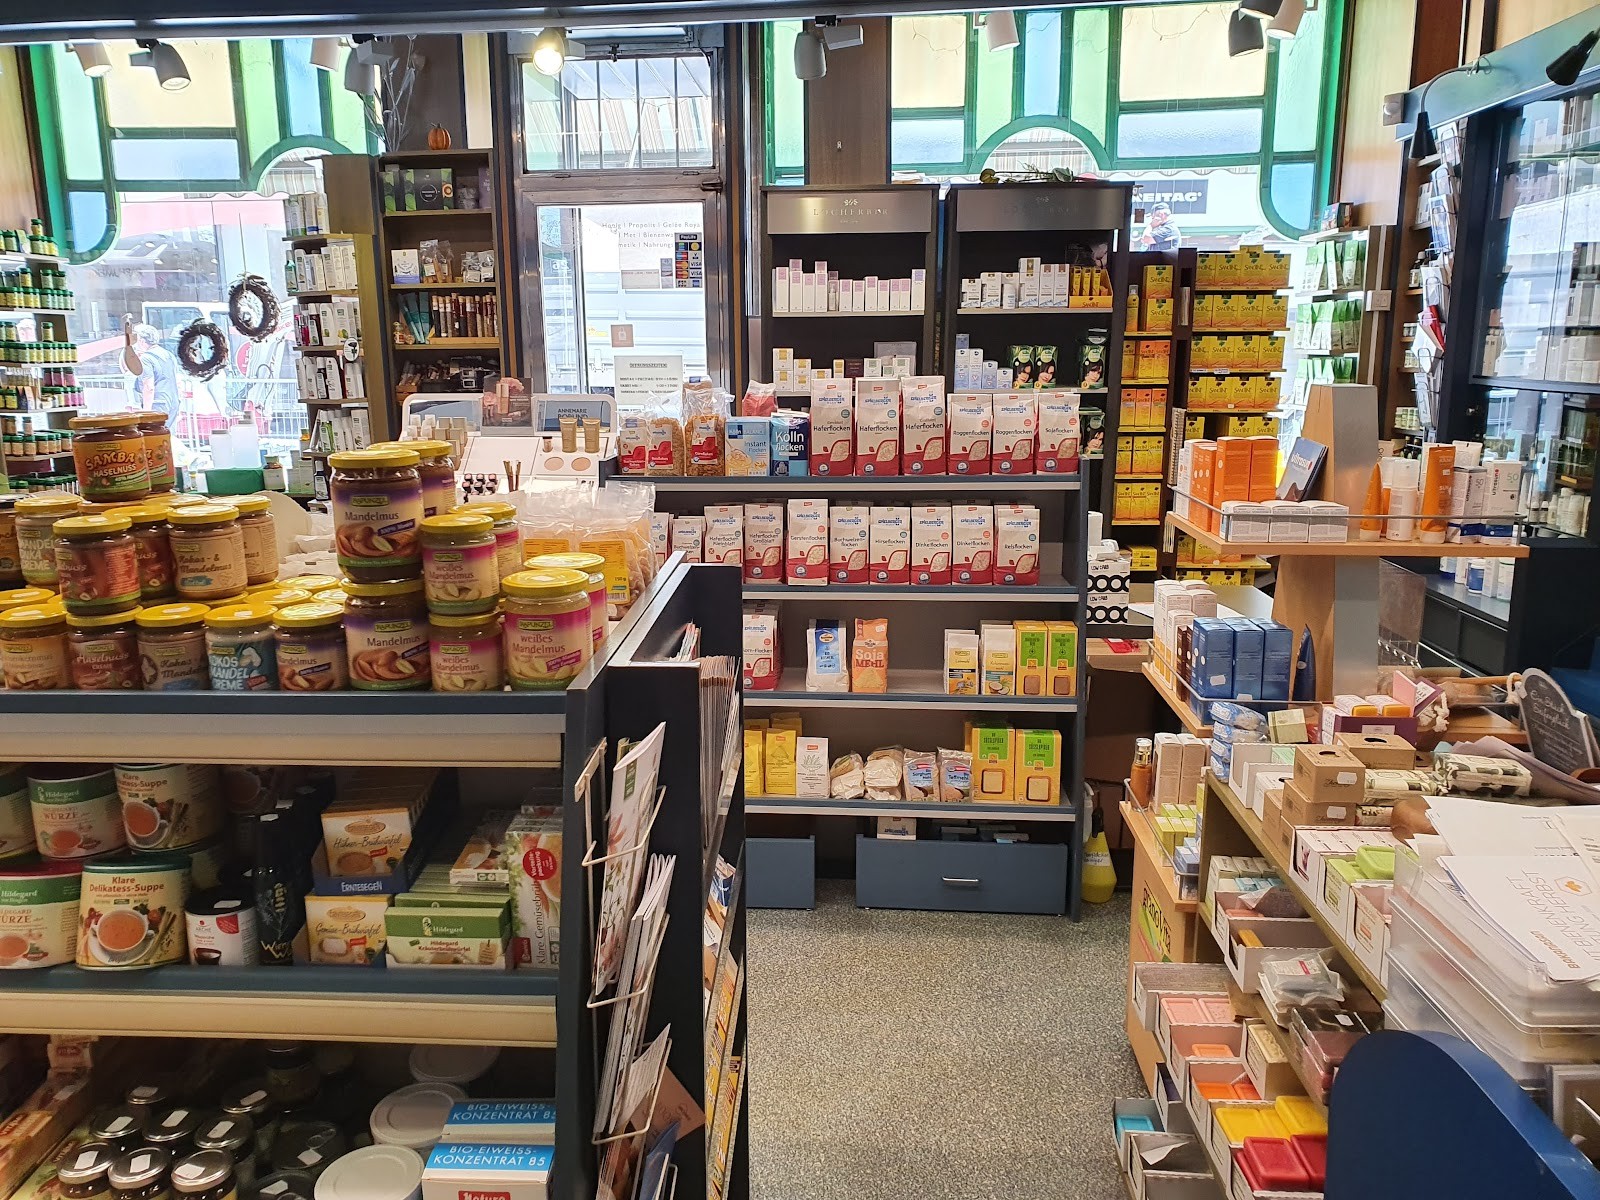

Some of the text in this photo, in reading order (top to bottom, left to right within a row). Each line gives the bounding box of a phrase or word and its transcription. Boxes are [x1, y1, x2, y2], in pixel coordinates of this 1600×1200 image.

[905, 422, 943, 431] Haferflocken
[775, 431, 804, 442] Kölln
[996, 429, 1032, 437] Roggenflocken
[86, 451, 135, 470] SAMBA
[93, 463, 137, 478] HASELNUSS
[345, 511, 399, 521] Mandelmus
[430, 572, 474, 580] Mandelmus
[367, 635, 421, 647] Mandelmus
[521, 634, 553, 643] weißes
[512, 643, 566, 655] Mandelmus
[443, 655, 469, 664] weißes
[856, 650, 884, 662] Soja
[855, 660, 885, 668] MEHL
[112, 876, 136, 884] Klare
[89, 883, 165, 895] Delikatess-Suppe
[341, 880, 383, 892] ERNTESEGEN
[433, 926, 464, 935] Hildegard
[536, 942, 546, 965] Klare
[452, 1111, 538, 1121] KONZENTRAT
[449, 1145, 537, 1155] BIO-EIWEISS-
[433, 1154, 546, 1167] KONZENTRAT 85
